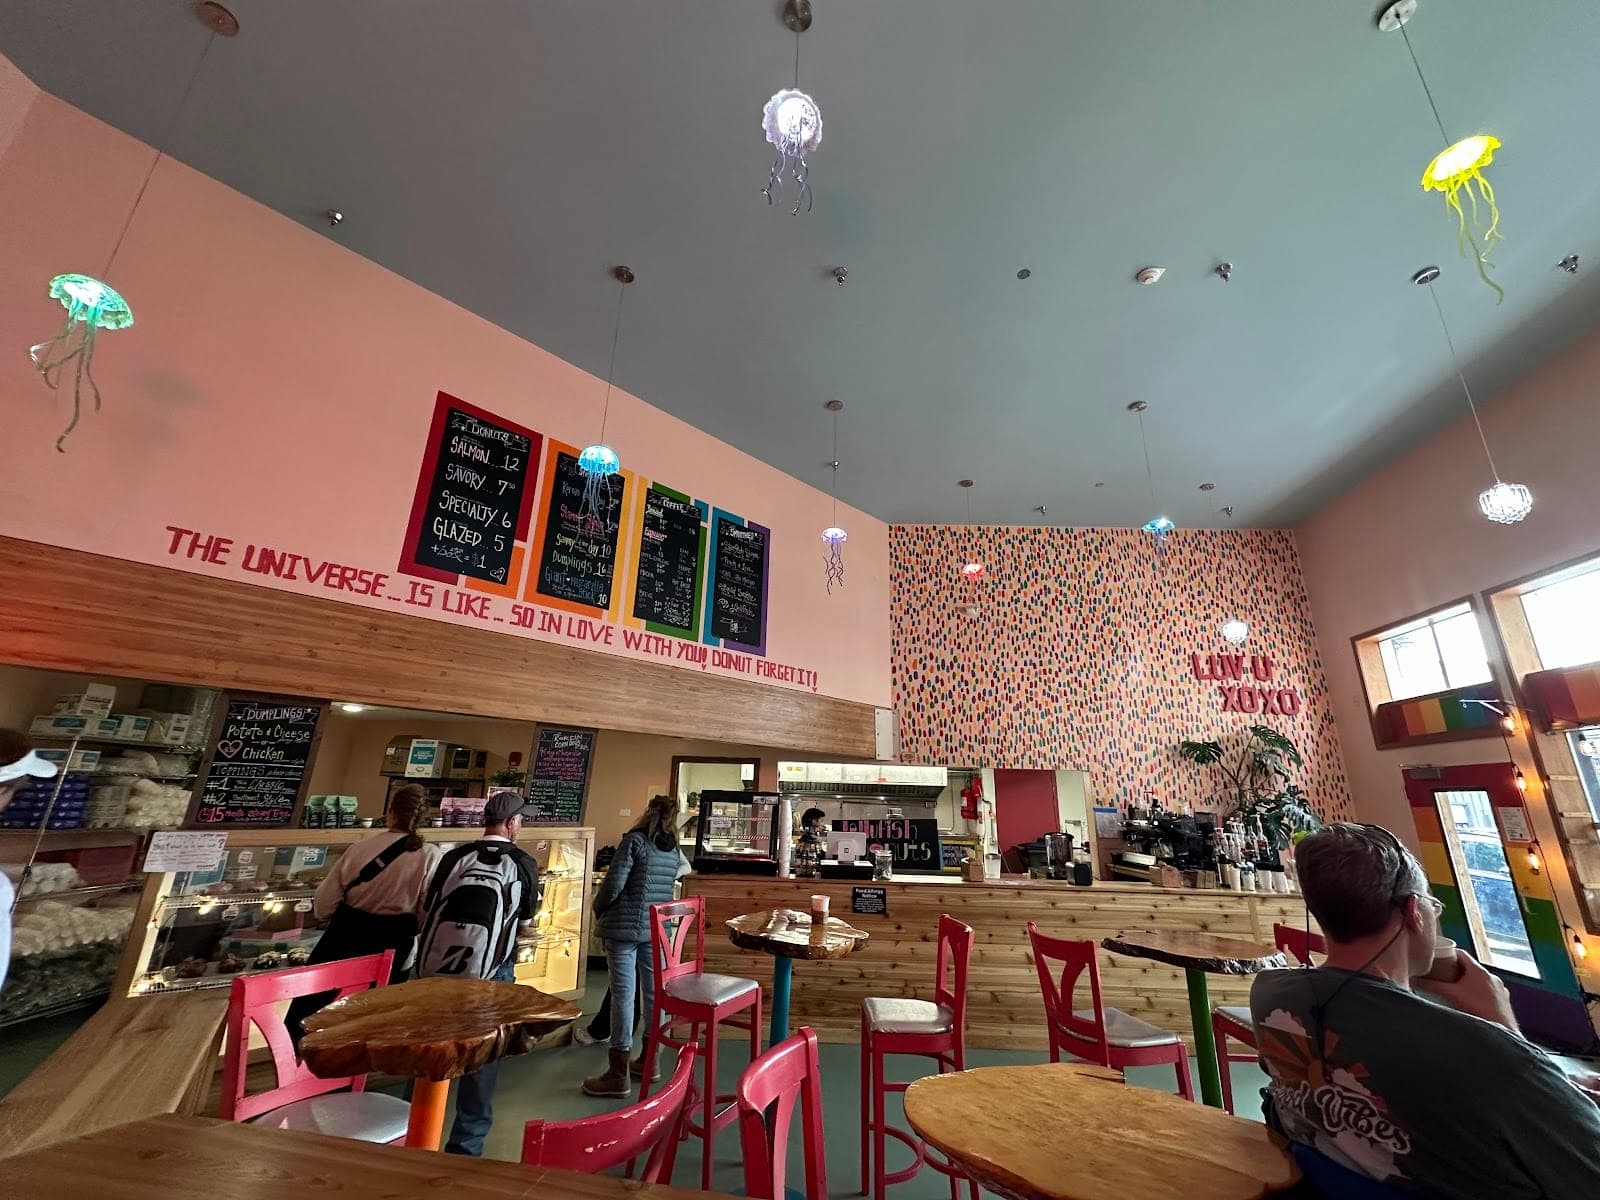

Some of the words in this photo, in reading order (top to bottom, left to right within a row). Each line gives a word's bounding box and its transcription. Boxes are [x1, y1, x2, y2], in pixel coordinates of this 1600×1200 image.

[471, 423, 510, 441] DONUTS
[502, 454, 520, 471] 12
[501, 512, 512, 528] 6
[494, 535, 506, 552] 5
[552, 549, 593, 578] Dumplings
[166, 525, 233, 565] THE
[406, 580, 435, 608] IS
[509, 604, 534, 629] SO
[536, 610, 563, 633] IN
[566, 616, 614, 646] LOVE
[622, 629, 673, 658] WITH
[711, 650, 753, 674] DONUT
[756, 660, 797, 682] FORGET
[1191, 652, 1244, 681] LUV
[1251, 654, 1274, 682] U
[1217, 685, 1301, 716] XOXO
[246, 706, 304, 721] DUMPLINGS
[227, 722, 264, 740] Potato
[273, 724, 311, 742] Cheese
[241, 745, 285, 761] Chicken
[215, 764, 265, 777] TOPPINGS
[205, 777, 231, 790] #1
[202, 793, 227, 806] #2
